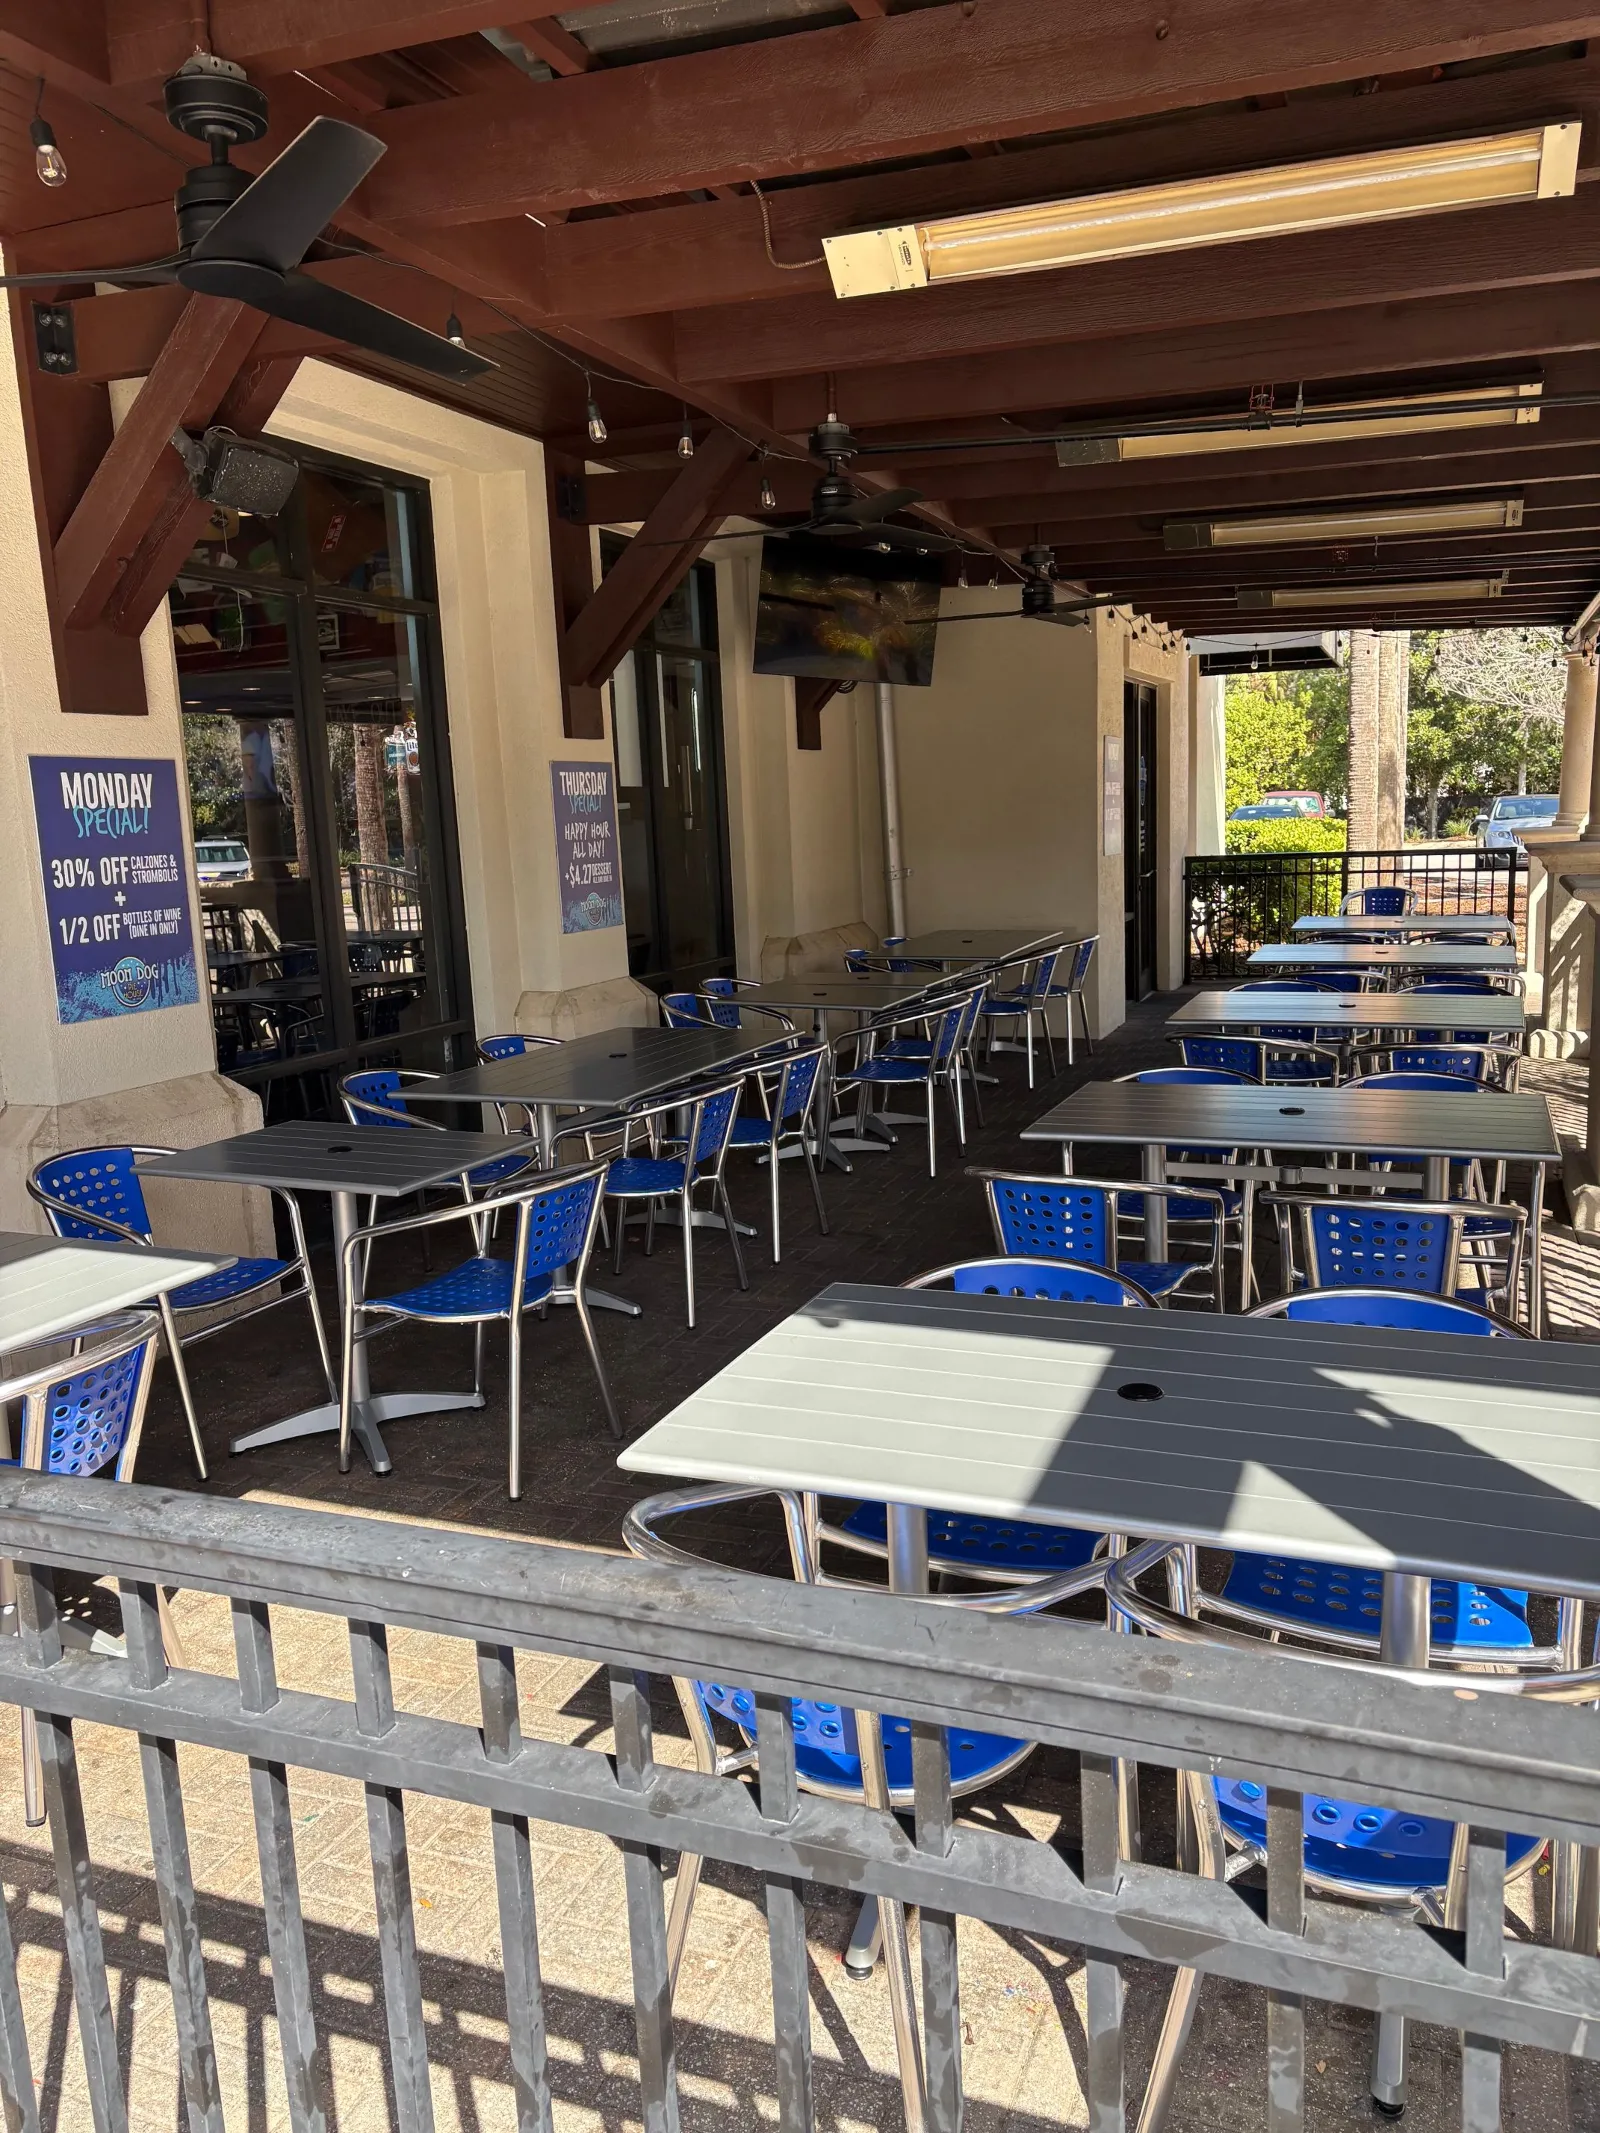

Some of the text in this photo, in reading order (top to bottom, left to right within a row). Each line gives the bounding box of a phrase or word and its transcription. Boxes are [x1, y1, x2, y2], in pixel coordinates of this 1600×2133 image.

[60, 772, 153, 809] MONDAY
[559, 771, 607, 796] THURSDAY
[569, 794, 602, 815] SPECIAL!
[73, 805, 149, 839] SPECIAL!
[564, 820, 611, 841] HAPPY HOUR
[572, 839, 605, 860] ALL DAY!
[51, 854, 177, 889] 30% OFF CALZONES &
[131, 868, 179, 884] STROMBOLIS
[59, 907, 182, 945] 1/2 OFF BOTTLES OF WINE
[128, 920, 179, 939] (DINE IN ONLY)
[100, 963, 159, 989] MOON DOG
